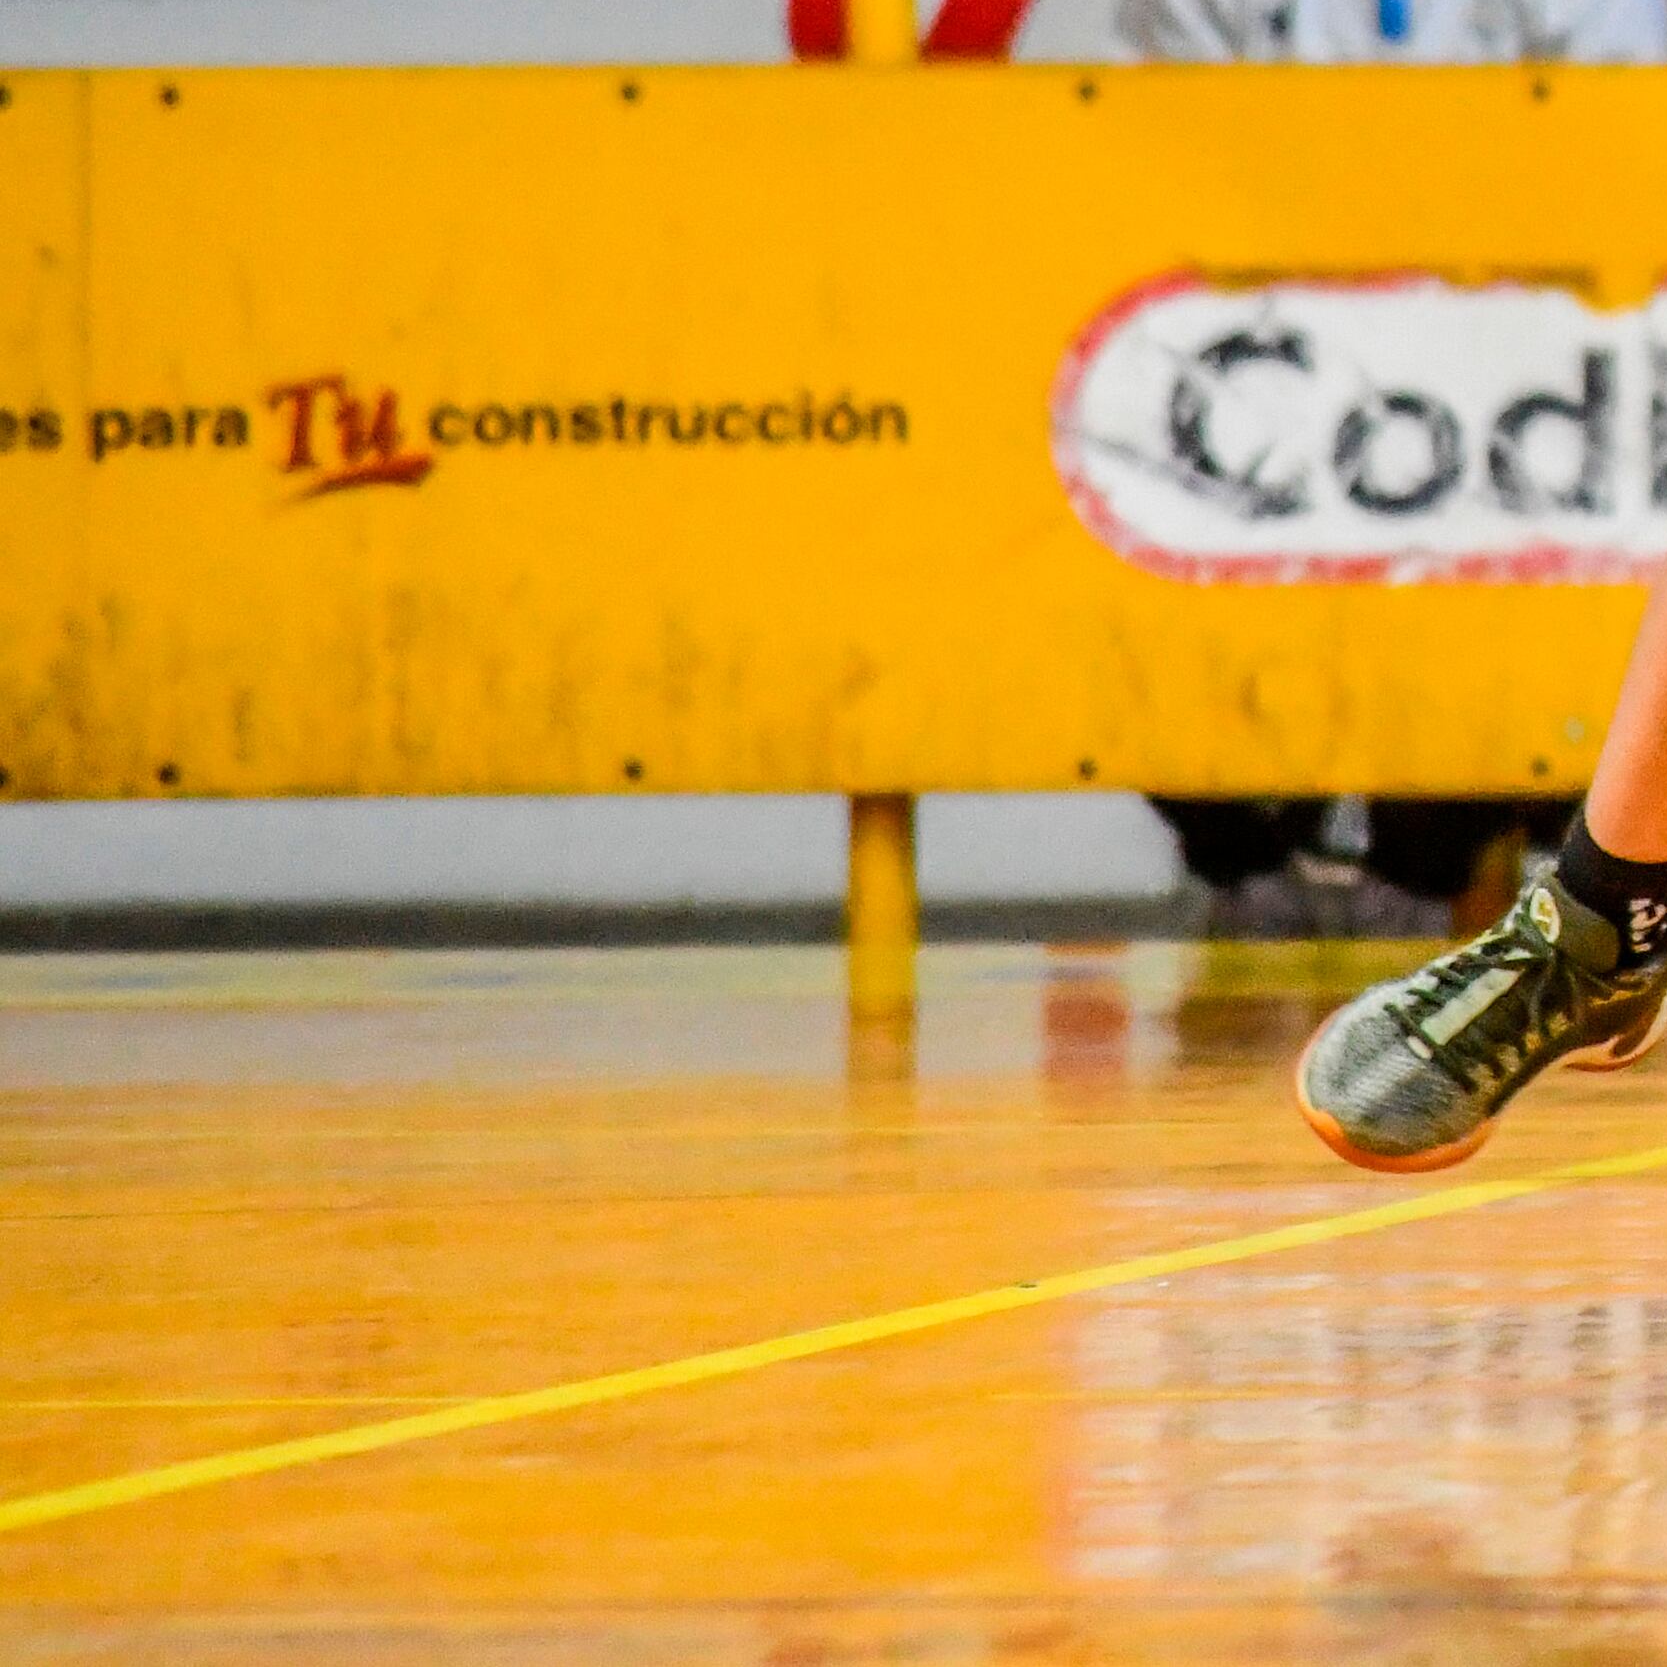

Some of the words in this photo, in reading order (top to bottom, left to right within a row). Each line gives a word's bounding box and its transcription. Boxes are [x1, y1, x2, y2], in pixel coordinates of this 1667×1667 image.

[92, 407, 250, 463] para
[265, 375, 403, 471] Tu
[429, 391, 909, 447] construcción
